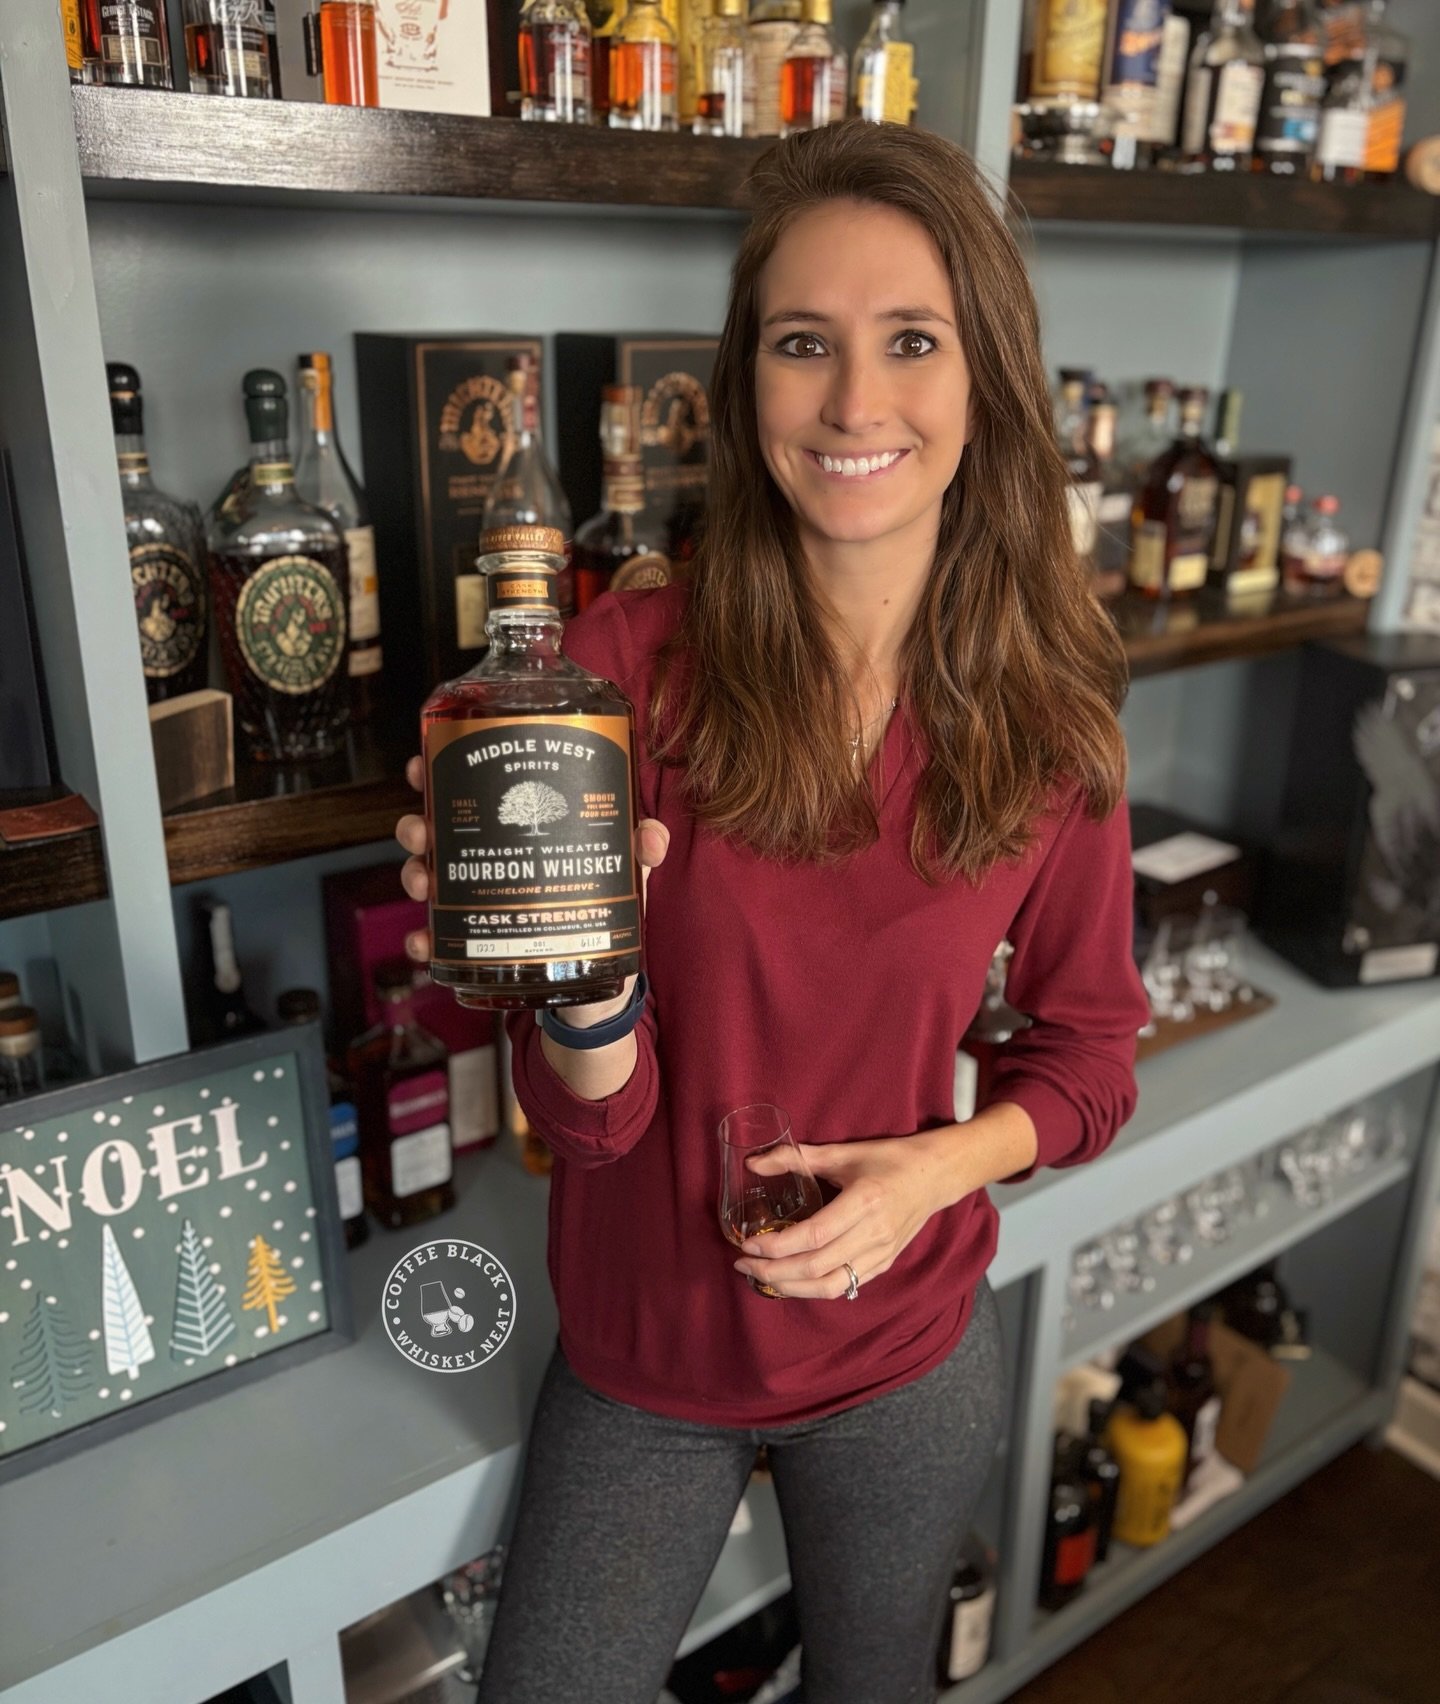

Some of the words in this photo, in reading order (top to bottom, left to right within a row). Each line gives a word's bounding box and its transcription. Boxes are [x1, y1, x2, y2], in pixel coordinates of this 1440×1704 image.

[467, 740, 537, 766] MIDDLE
[545, 740, 595, 761] WEST
[504, 760, 560, 773] SPIRITS
[583, 793, 615, 803] SMOOTH
[461, 847, 534, 858] STRAIGHT
[541, 842, 609, 854] WHEATED
[449, 861, 534, 881] BOURBON
[543, 855, 622, 878] WHISKEY
[468, 914, 512, 925] CASK
[516, 908, 608, 924] STRENGTH
[1, 1103, 267, 1246] NOEL
